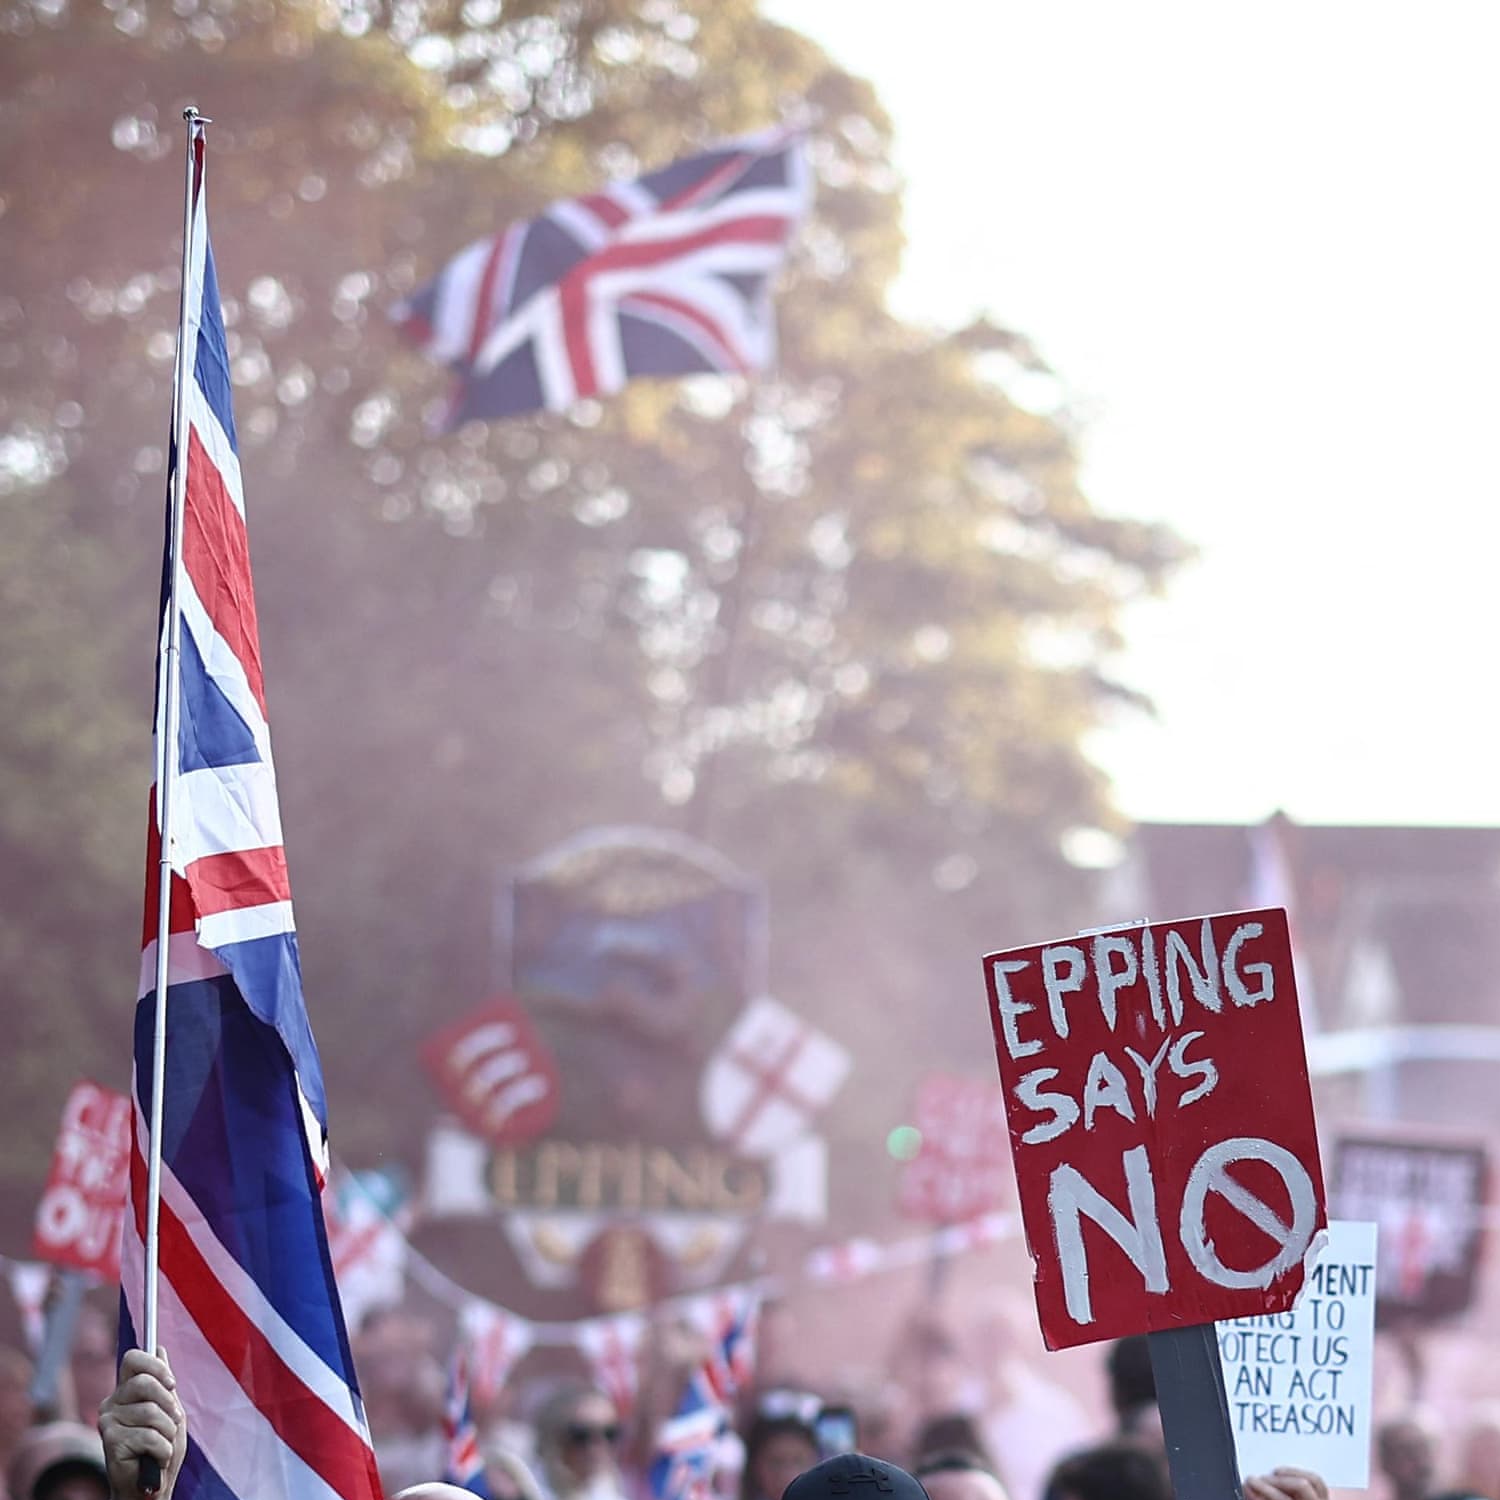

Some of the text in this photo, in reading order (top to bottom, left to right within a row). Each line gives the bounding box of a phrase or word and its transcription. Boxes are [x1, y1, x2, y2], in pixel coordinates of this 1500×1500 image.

[994, 918, 1274, 1060] EPPING
[1013, 1031, 1219, 1144] SAYS
[1046, 1138, 1318, 1324] NO
[1309, 1299, 1345, 1330] TO
[1219, 1331, 1349, 1367] OTECT US
[1234, 1365, 1343, 1401] AN ACT
[1234, 1402, 1355, 1437] TREASON
